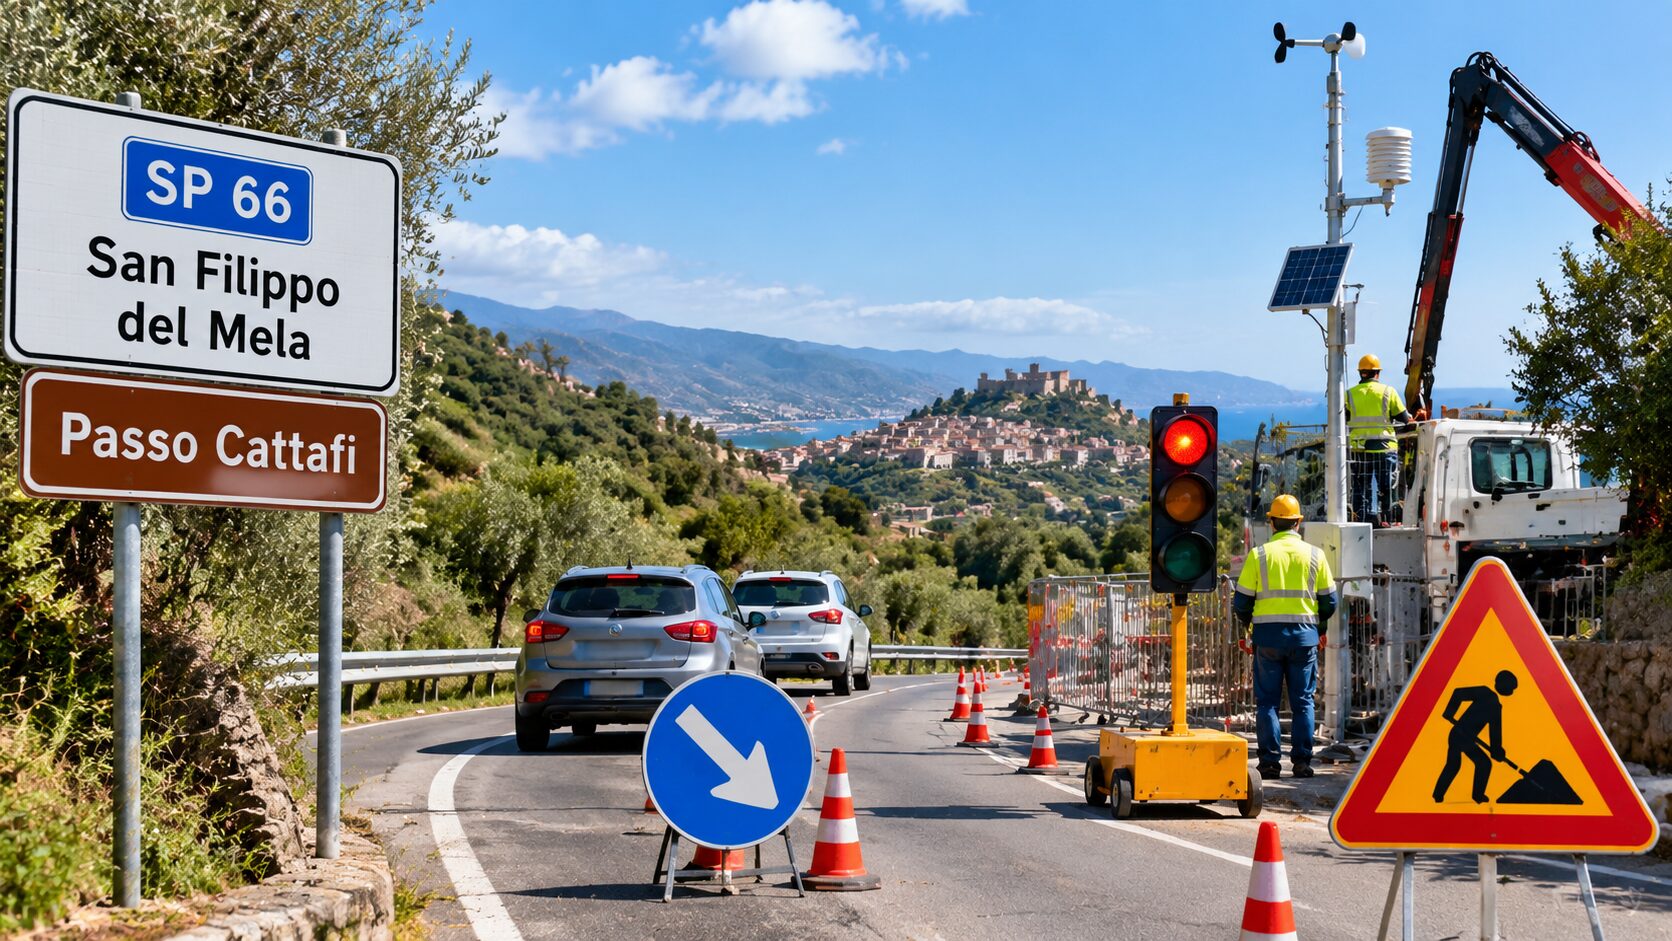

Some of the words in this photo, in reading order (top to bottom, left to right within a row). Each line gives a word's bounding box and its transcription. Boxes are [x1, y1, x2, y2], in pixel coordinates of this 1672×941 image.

[145, 159, 213, 209] SP
[232, 175, 292, 223] 66
[86, 235, 175, 286] San
[196, 249, 340, 313] Filippo
[117, 301, 188, 347] del
[209, 310, 311, 360] Mela
[61, 411, 198, 464] Passo
[215, 424, 357, 474] Cattafi
